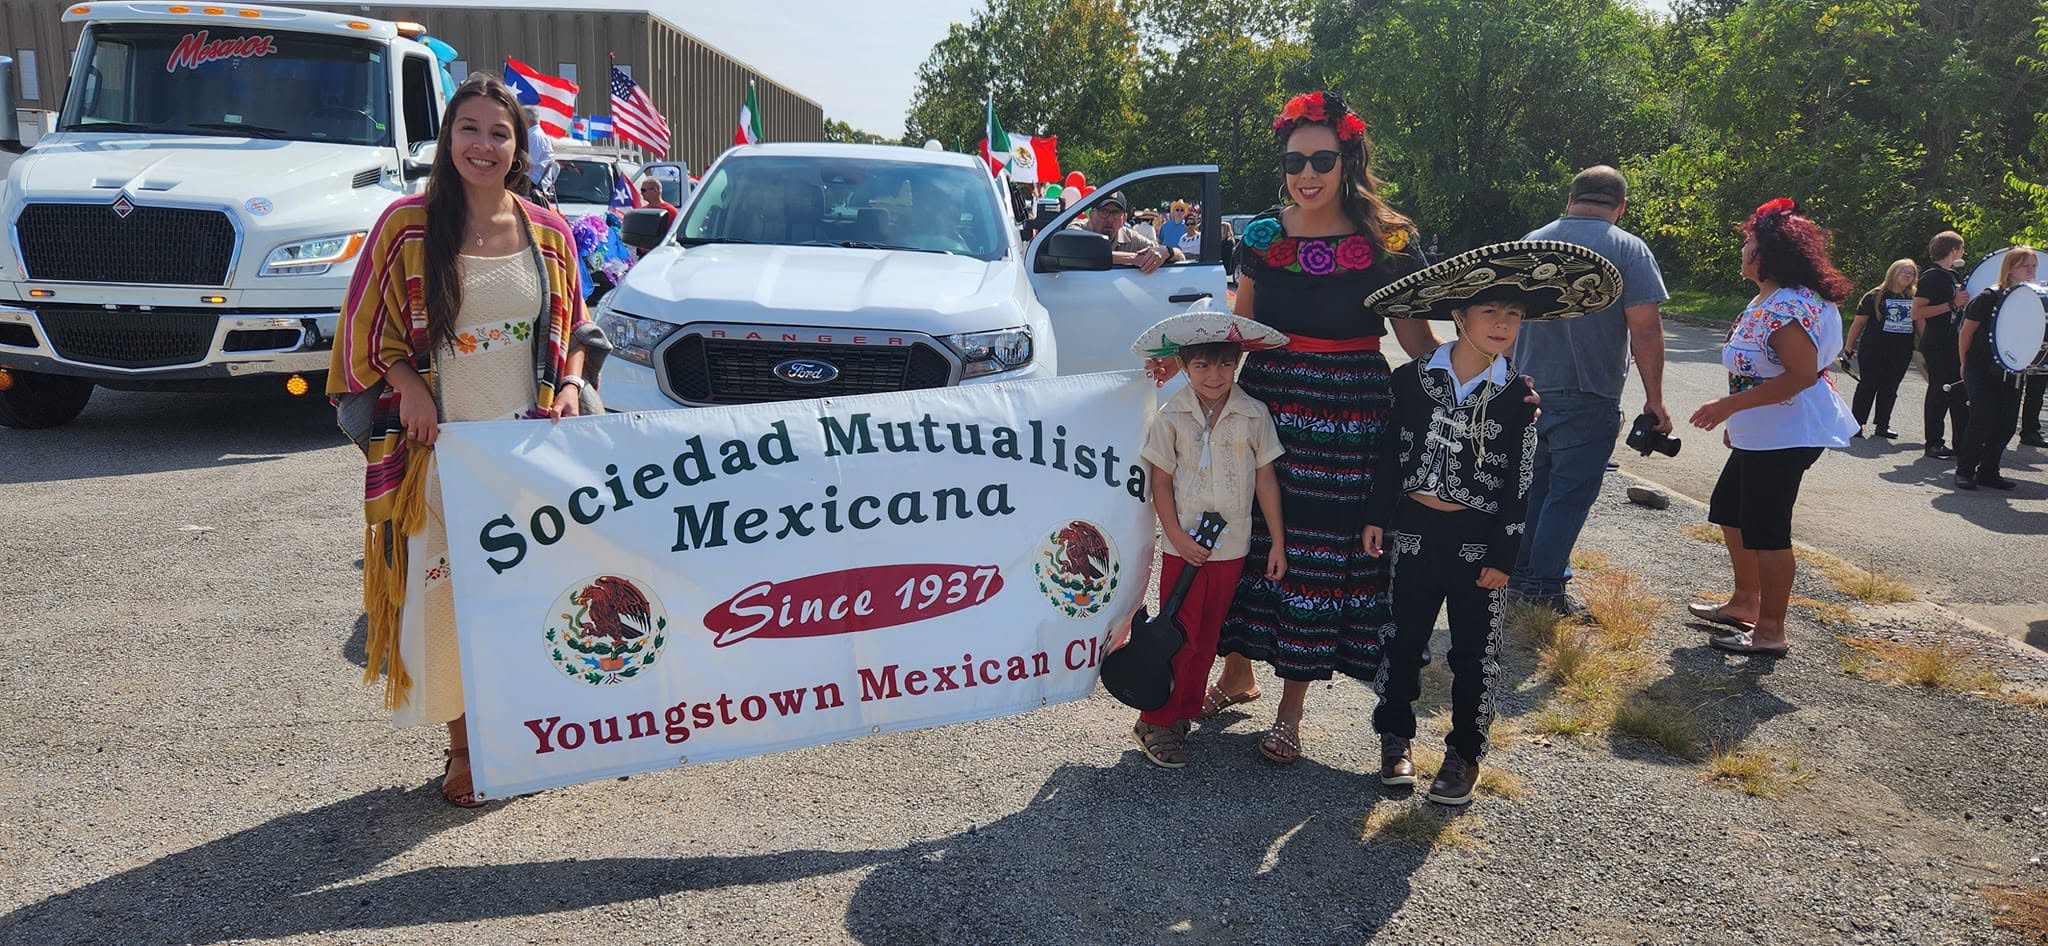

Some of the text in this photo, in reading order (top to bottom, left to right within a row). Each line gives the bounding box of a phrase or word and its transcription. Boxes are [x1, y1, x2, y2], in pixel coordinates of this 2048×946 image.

[167, 30, 277, 72] Mesaros
[712, 330, 902, 345] RANGER
[788, 362, 823, 379] Ford
[479, 412, 1146, 574] Sociedad Mutualista
[671, 483, 1014, 552] Mexicana
[712, 566, 998, 646] Since 1937
[525, 630, 1112, 754] Youngstown Mexican Cl
